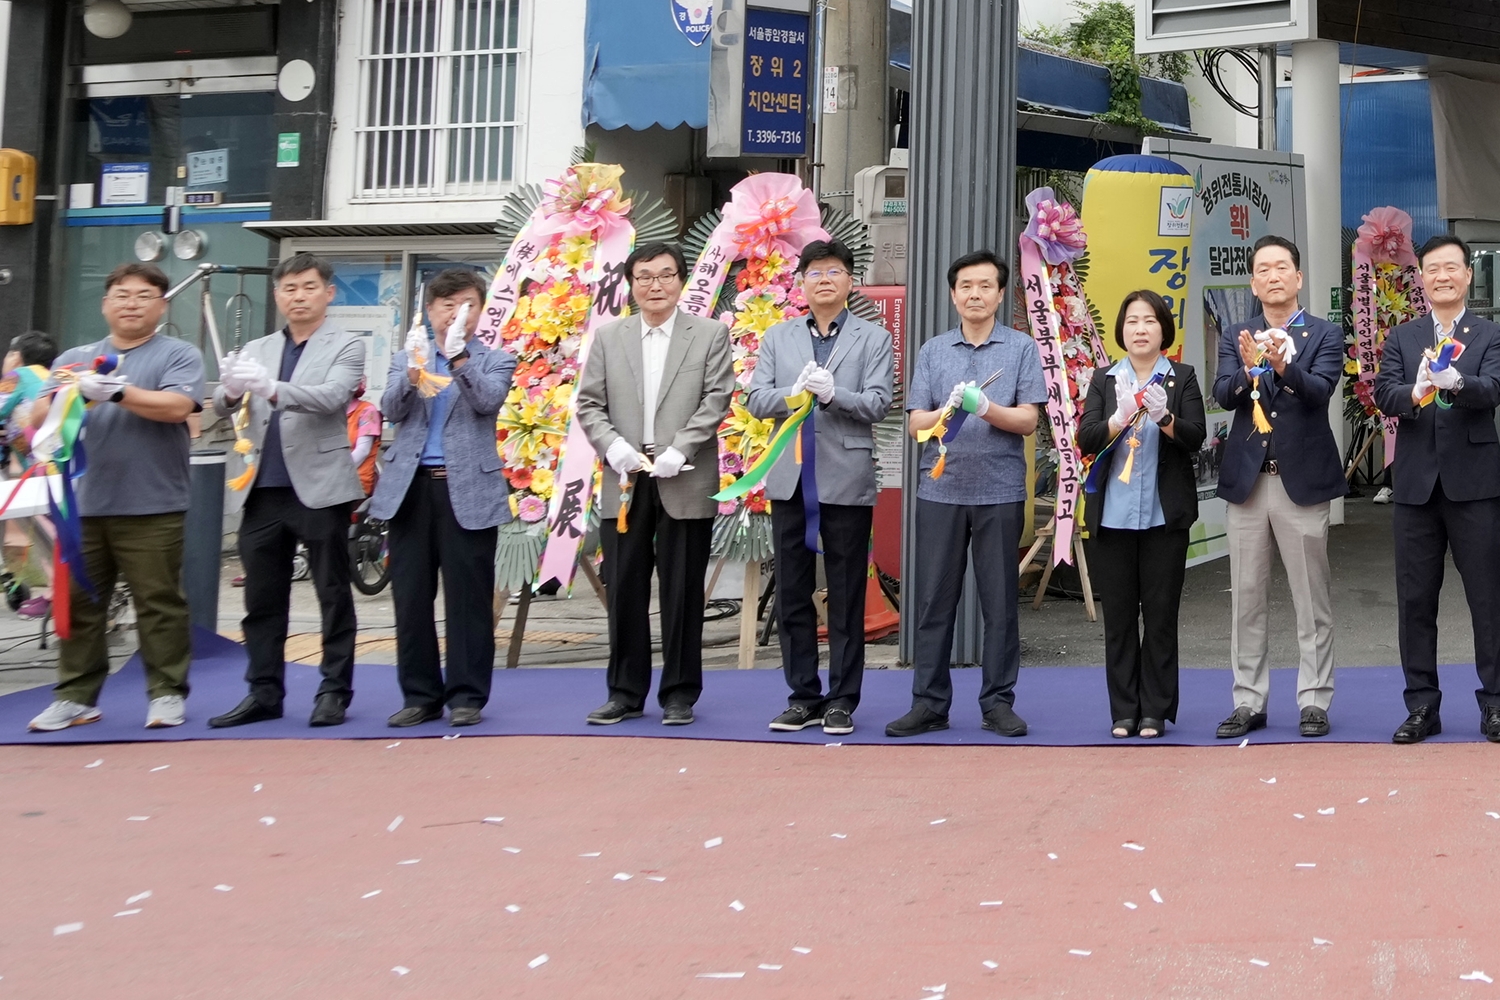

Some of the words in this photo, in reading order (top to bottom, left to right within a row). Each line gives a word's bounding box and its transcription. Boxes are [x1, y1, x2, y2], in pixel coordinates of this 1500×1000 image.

[686, 25, 711, 34] POLICE
[748, 26, 805, 45] 서울종암경찰서
[748, 91, 802, 114] 치안센터
[826, 87, 835, 99] 14
[756, 130, 801, 145] 3396-7316
[1201, 172, 1272, 223] 장위전통시장이
[1229, 204, 1250, 240] 확!
[892, 298, 902, 350] Emergency
[894, 352, 902, 370] Fire
[1025, 273, 1074, 522] 서울북부새마을금고
